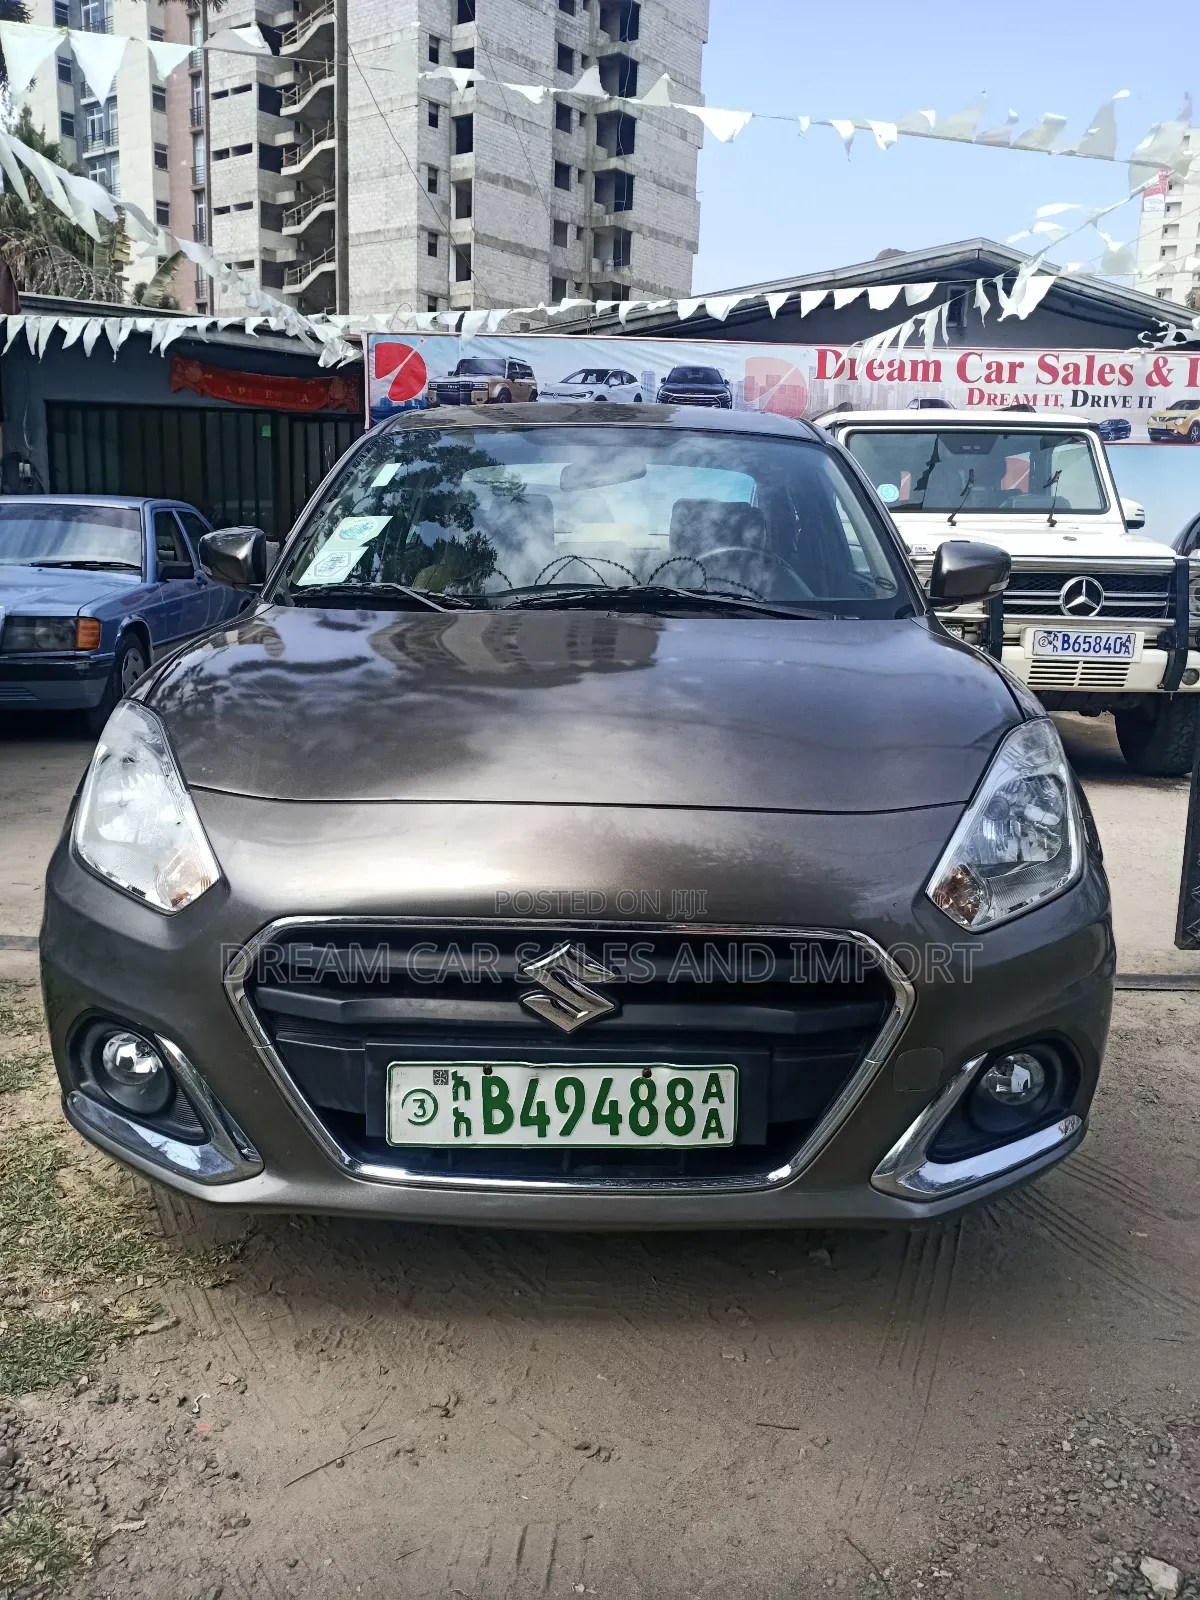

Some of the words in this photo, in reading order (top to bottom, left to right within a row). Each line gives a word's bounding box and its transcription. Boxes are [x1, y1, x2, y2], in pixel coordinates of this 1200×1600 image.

[813, 348, 942, 384] Dream
[956, 350, 1025, 384] Car
[1036, 353, 1134, 387] Sales
[1145, 355, 1174, 388] &
[1137, 395, 1156, 409] IT
[481, 1075, 697, 1138] B49488
